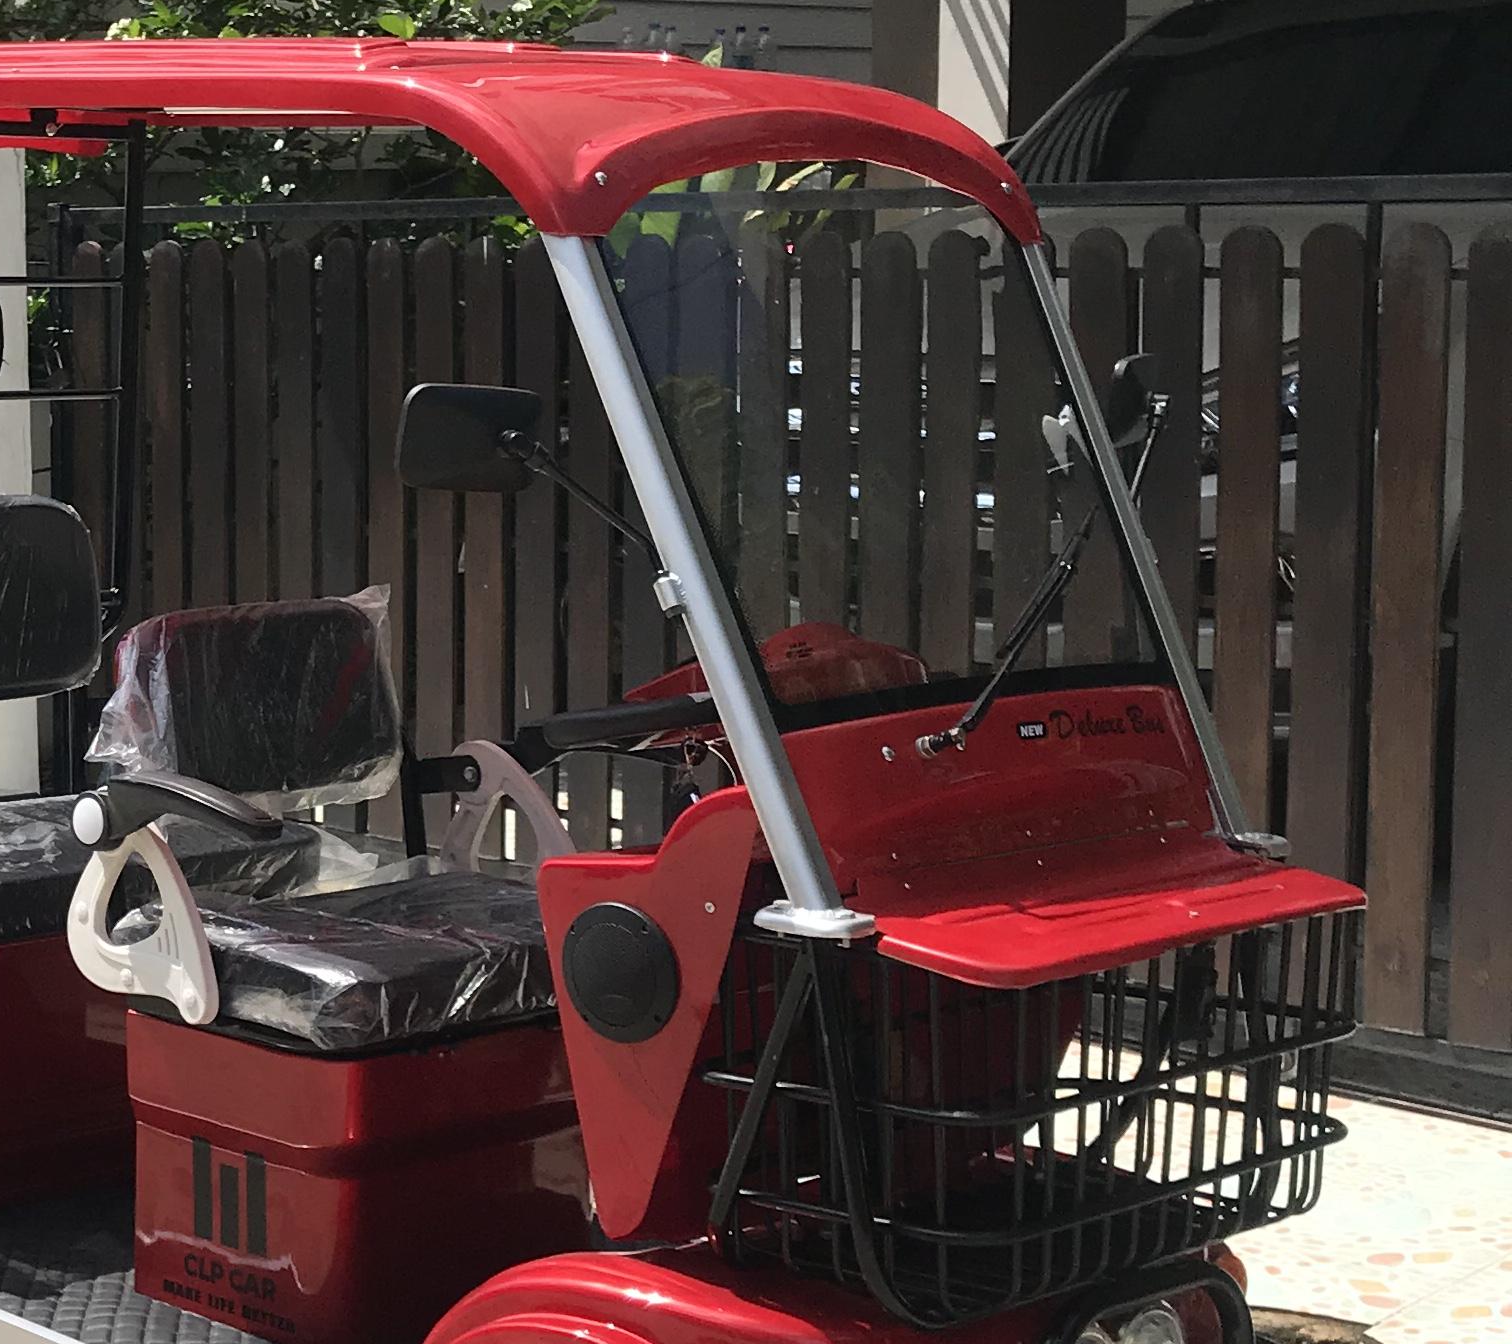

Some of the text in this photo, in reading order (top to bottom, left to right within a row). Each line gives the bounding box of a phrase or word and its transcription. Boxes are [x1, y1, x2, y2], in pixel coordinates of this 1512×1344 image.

[1019, 704, 1165, 739] NEW Deluxe Bus
[184, 1253, 276, 1302] CLP CAR
[163, 1279, 201, 1303] MAKE
[208, 1293, 236, 1314] LIFE
